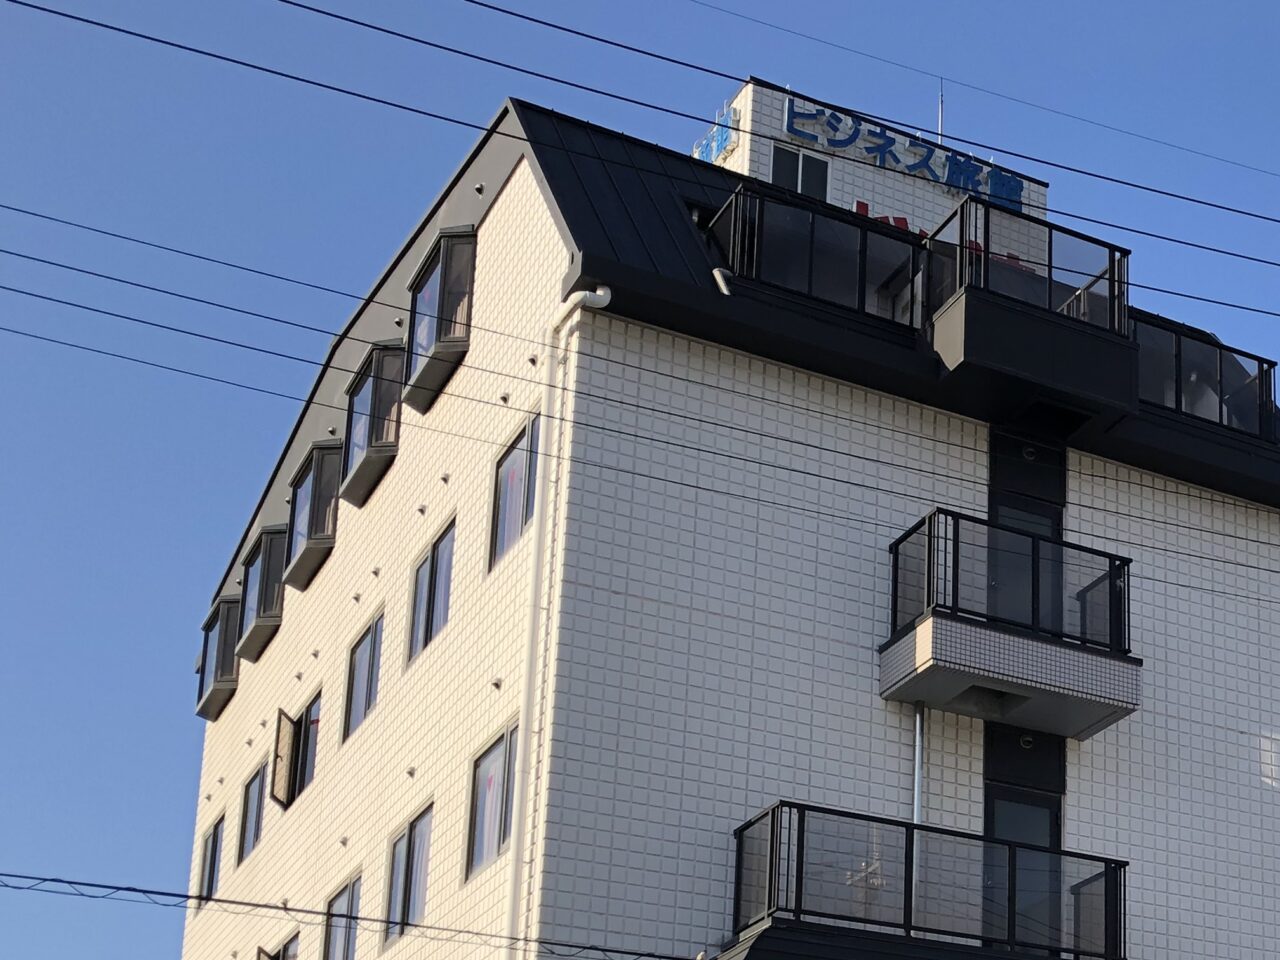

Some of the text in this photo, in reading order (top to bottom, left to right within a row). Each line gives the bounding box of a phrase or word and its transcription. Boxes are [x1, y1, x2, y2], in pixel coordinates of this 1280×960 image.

[784, 97, 1025, 213] ビジネス旅館
